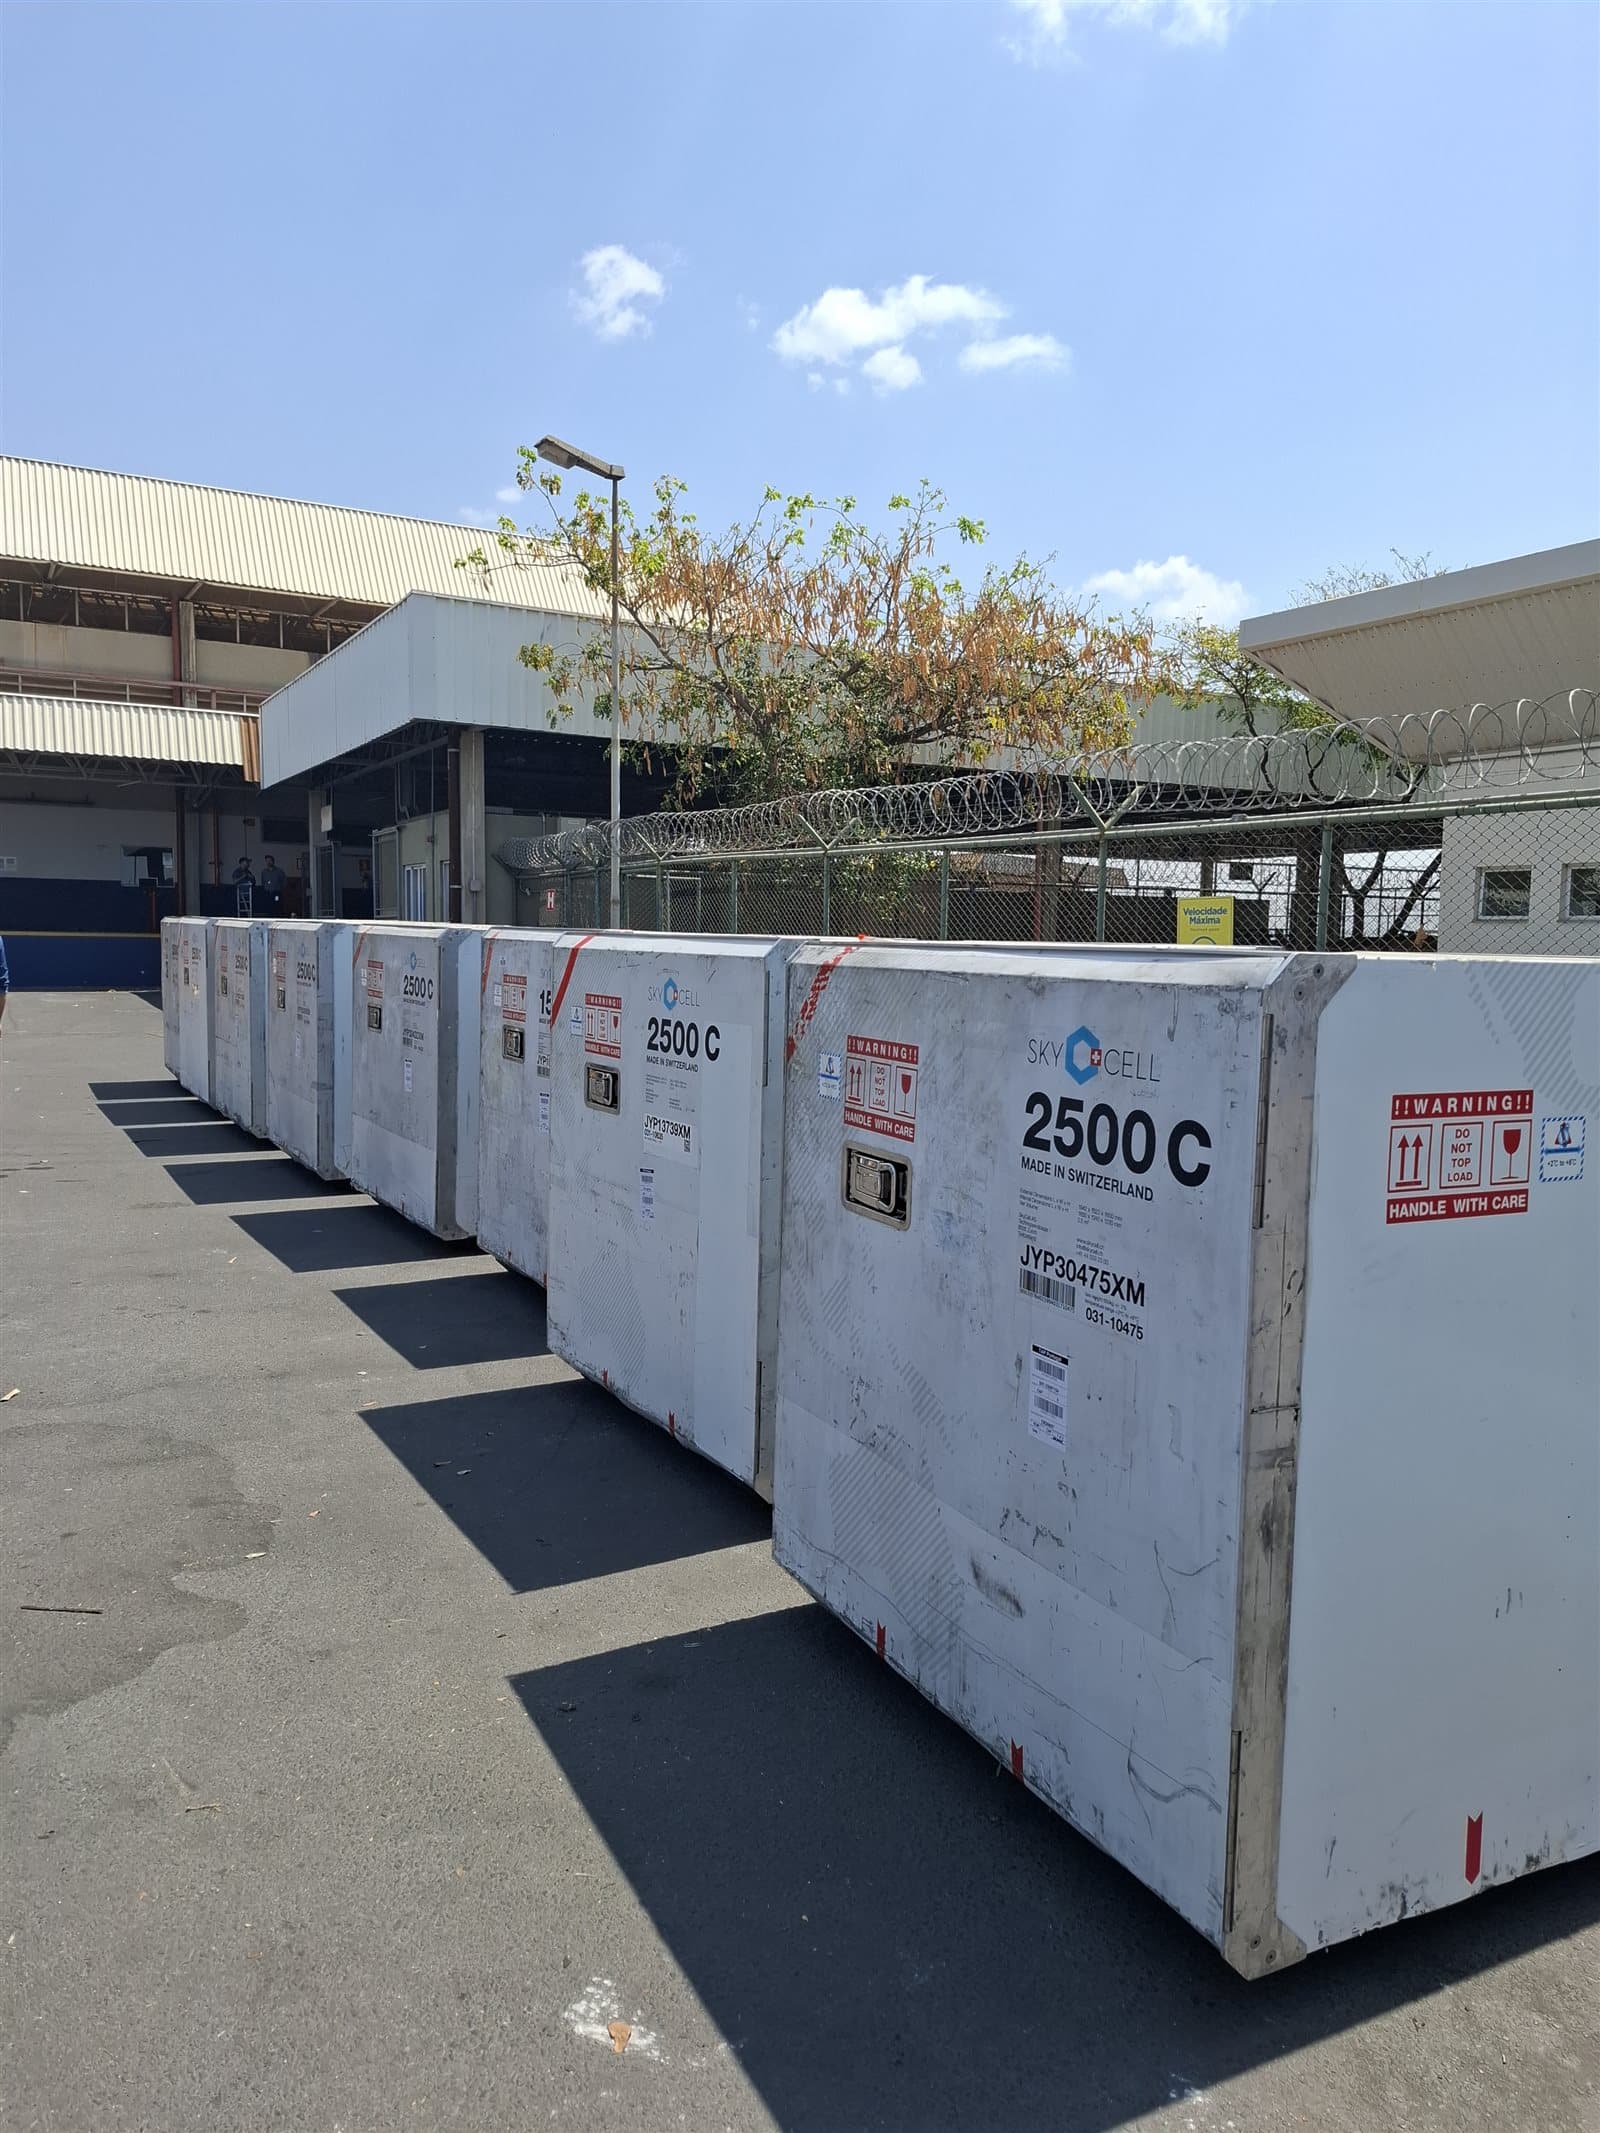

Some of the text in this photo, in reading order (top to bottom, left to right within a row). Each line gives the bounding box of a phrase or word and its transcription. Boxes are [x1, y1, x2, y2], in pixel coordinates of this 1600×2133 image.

[1183, 906, 1228, 916] Velocidade
[1189, 916, 1221, 925] Máxima
[403, 974, 434, 1000] 2500 C
[647, 1016, 721, 1061] 2500 C
[646, 1055, 659, 1065] MADE
[665, 1059, 699, 1072] SWITZERLAND
[1027, 1038, 1161, 1083] SKY CELL
[876, 1066, 885, 1075] DO
[874, 1076, 886, 1086] NOT
[874, 1087, 885, 1096] TOP
[872, 1098, 886, 1107] LOAD
[644, 1115, 691, 1139] JYP13739XM
[845, 1110, 914, 1138] HANDLE WITH CARE
[1022, 1091, 1212, 1187] 2500 C
[1455, 1128, 1470, 1139] DO
[1450, 1142, 1472, 1154] NOT
[1451, 1157, 1471, 1168] TOP
[1021, 1156, 1052, 1176] MADE
[1054, 1165, 1065, 1179] IN
[1068, 1168, 1154, 1202] SWITZERLAND
[1447, 1171, 1473, 1182] LOAD
[1389, 1194, 1527, 1219] HANDLE WITH CARE
[1020, 1244, 1145, 1307] JYP30475XM
[1085, 1307, 1144, 1340] 031-10475
